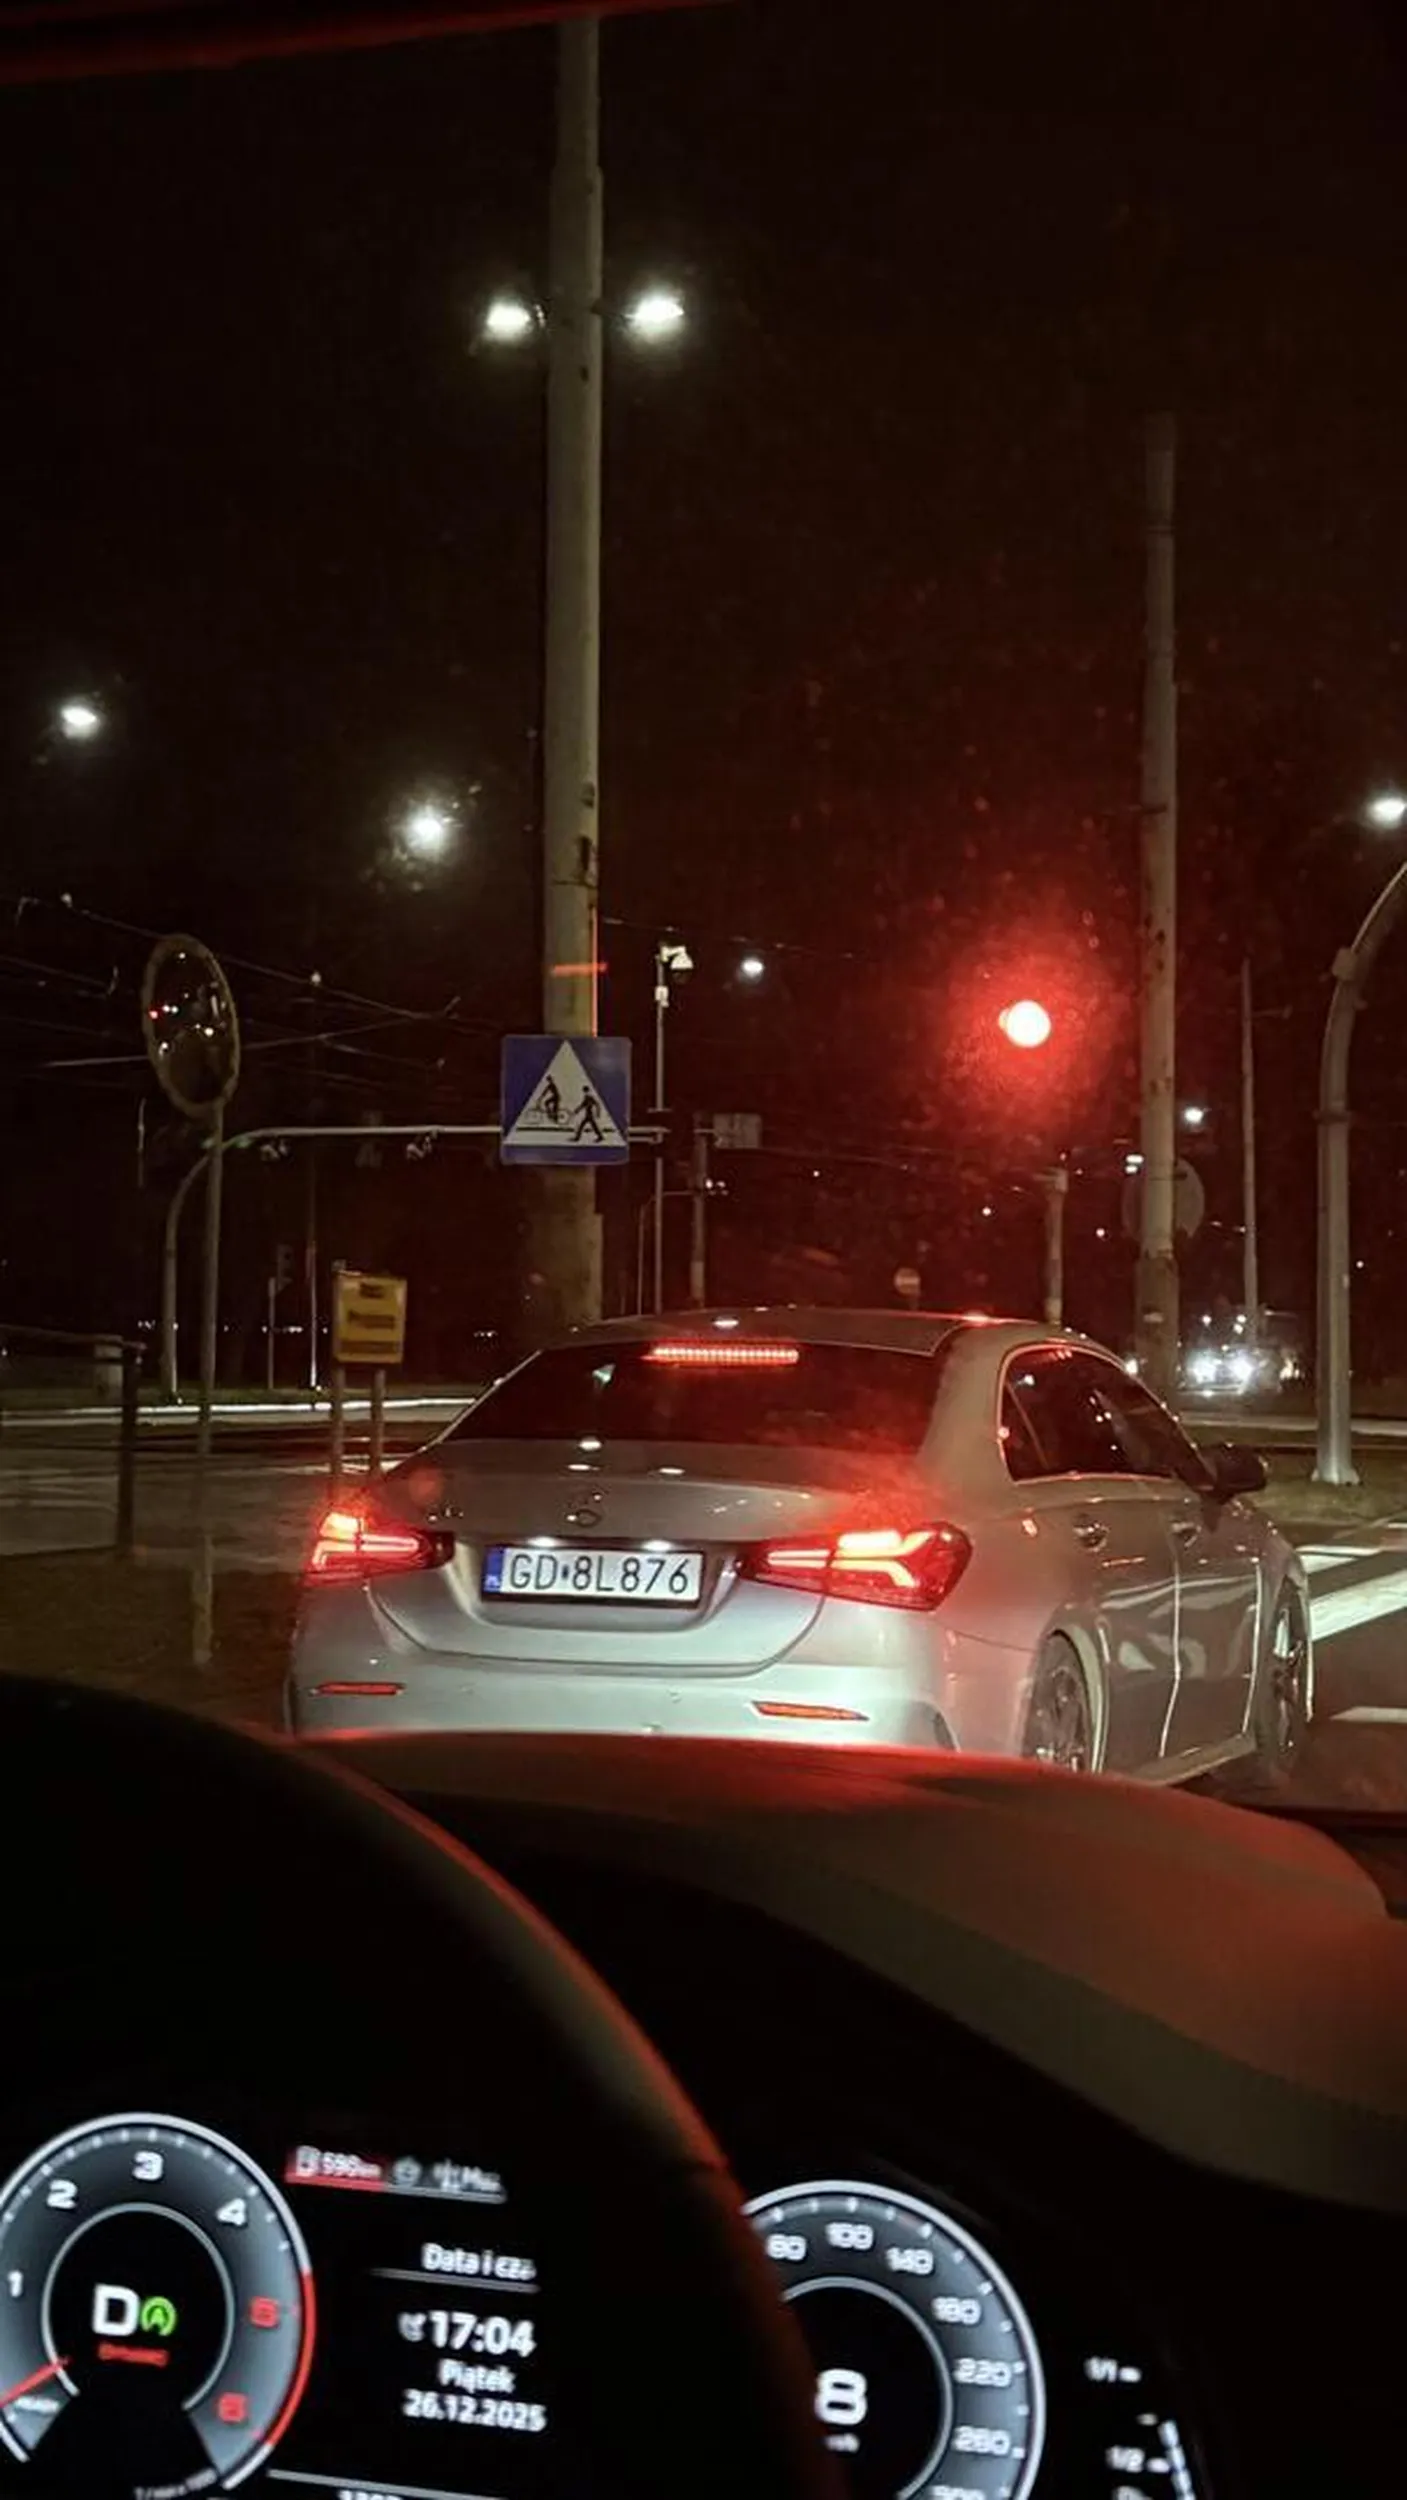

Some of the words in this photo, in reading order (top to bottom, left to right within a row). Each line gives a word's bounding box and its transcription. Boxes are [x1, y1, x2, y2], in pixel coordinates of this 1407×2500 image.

[509, 1553, 557, 1590] GD
[572, 1555, 689, 1594] 8L876
[133, 2151, 164, 2181] 3
[46, 2179, 78, 2209] 2
[216, 2198, 247, 2226] 4
[826, 2222, 874, 2250] 100
[422, 2242, 479, 2275] Data
[886, 2247, 934, 2275] 140
[8, 2270, 23, 2297] 1
[93, 2282, 140, 2336] D
[932, 2297, 982, 2325] 180
[429, 2310, 537, 2357] 17:04
[438, 2358, 516, 2394] Piątek
[953, 2357, 1012, 2388] 220
[402, 2388, 547, 2432] 26.12.2025
[814, 2368, 868, 2426] 8
[953, 2425, 1010, 2456] 260
